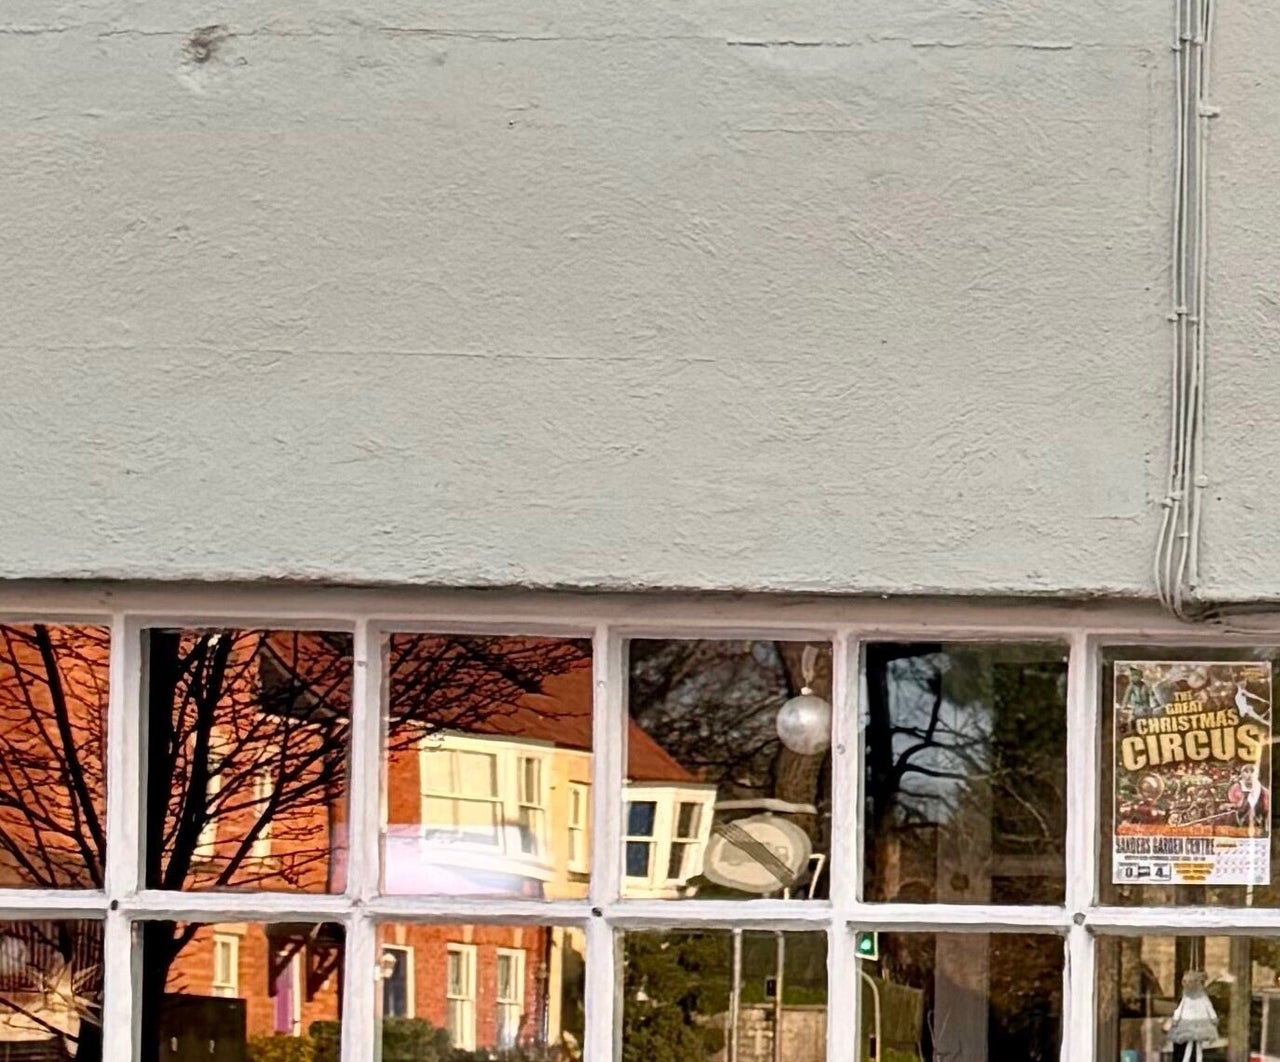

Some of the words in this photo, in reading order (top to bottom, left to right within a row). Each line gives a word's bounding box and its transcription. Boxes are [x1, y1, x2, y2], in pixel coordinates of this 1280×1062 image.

[1173, 691, 1193, 702] THE
[1165, 701, 1204, 715] GREAT
[1135, 709, 1239, 735] CHRISTMAS
[1121, 724, 1261, 771] CIRCUS
[1116, 838, 1151, 855] SANDERS
[1153, 838, 1183, 855] GARDEN
[1185, 838, 1215, 856] CENTRE
